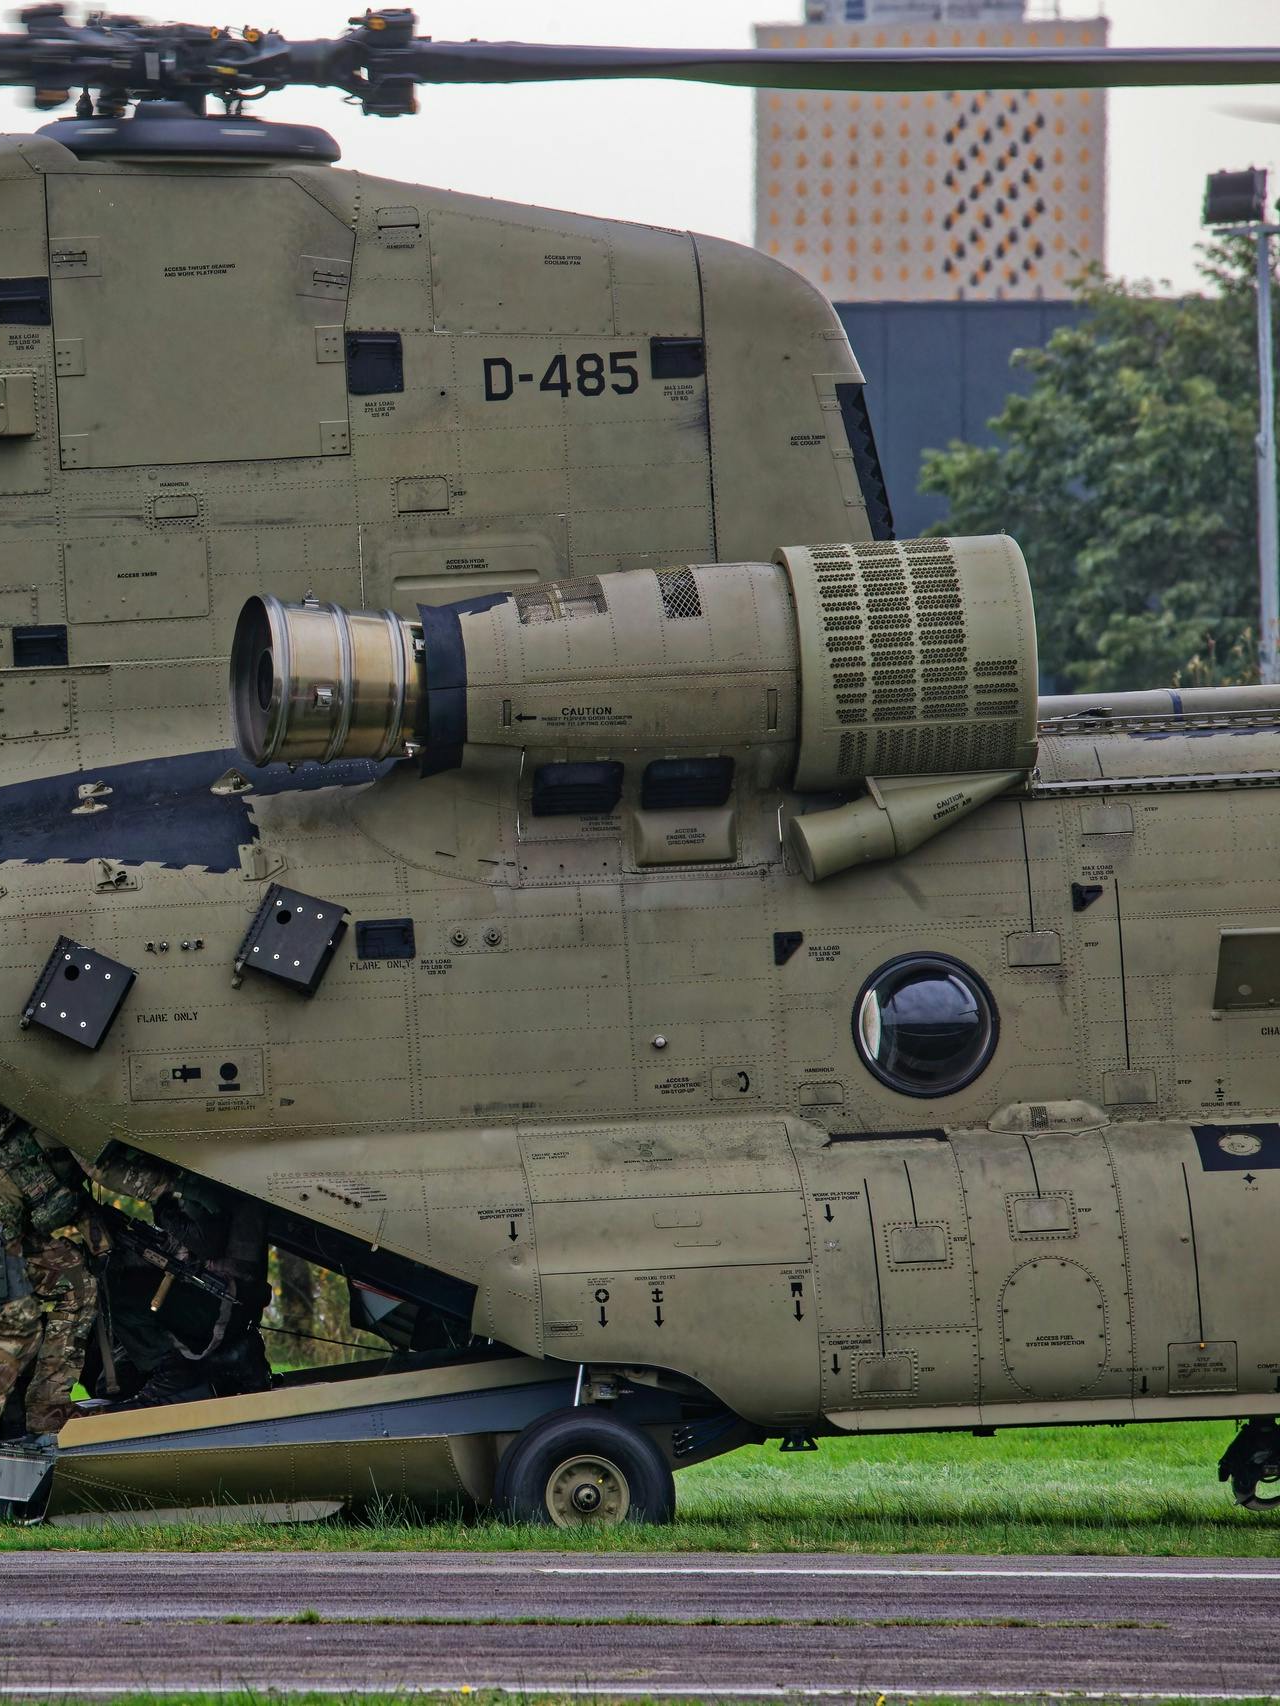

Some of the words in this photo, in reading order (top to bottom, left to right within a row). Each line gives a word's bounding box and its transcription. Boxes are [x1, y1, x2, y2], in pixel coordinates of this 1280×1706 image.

[483, 351, 639, 401] D-485
[561, 707, 612, 716] CAUTION
[936, 791, 964, 809] CAUTION
[933, 803, 959, 820] EXHAUST
[962, 797, 972, 807] AIR
[349, 960, 381, 971] FLARE
[386, 959, 411, 969] ONLY
[137, 1013, 168, 1023] FLARE
[174, 1011, 198, 1022] ONLY
